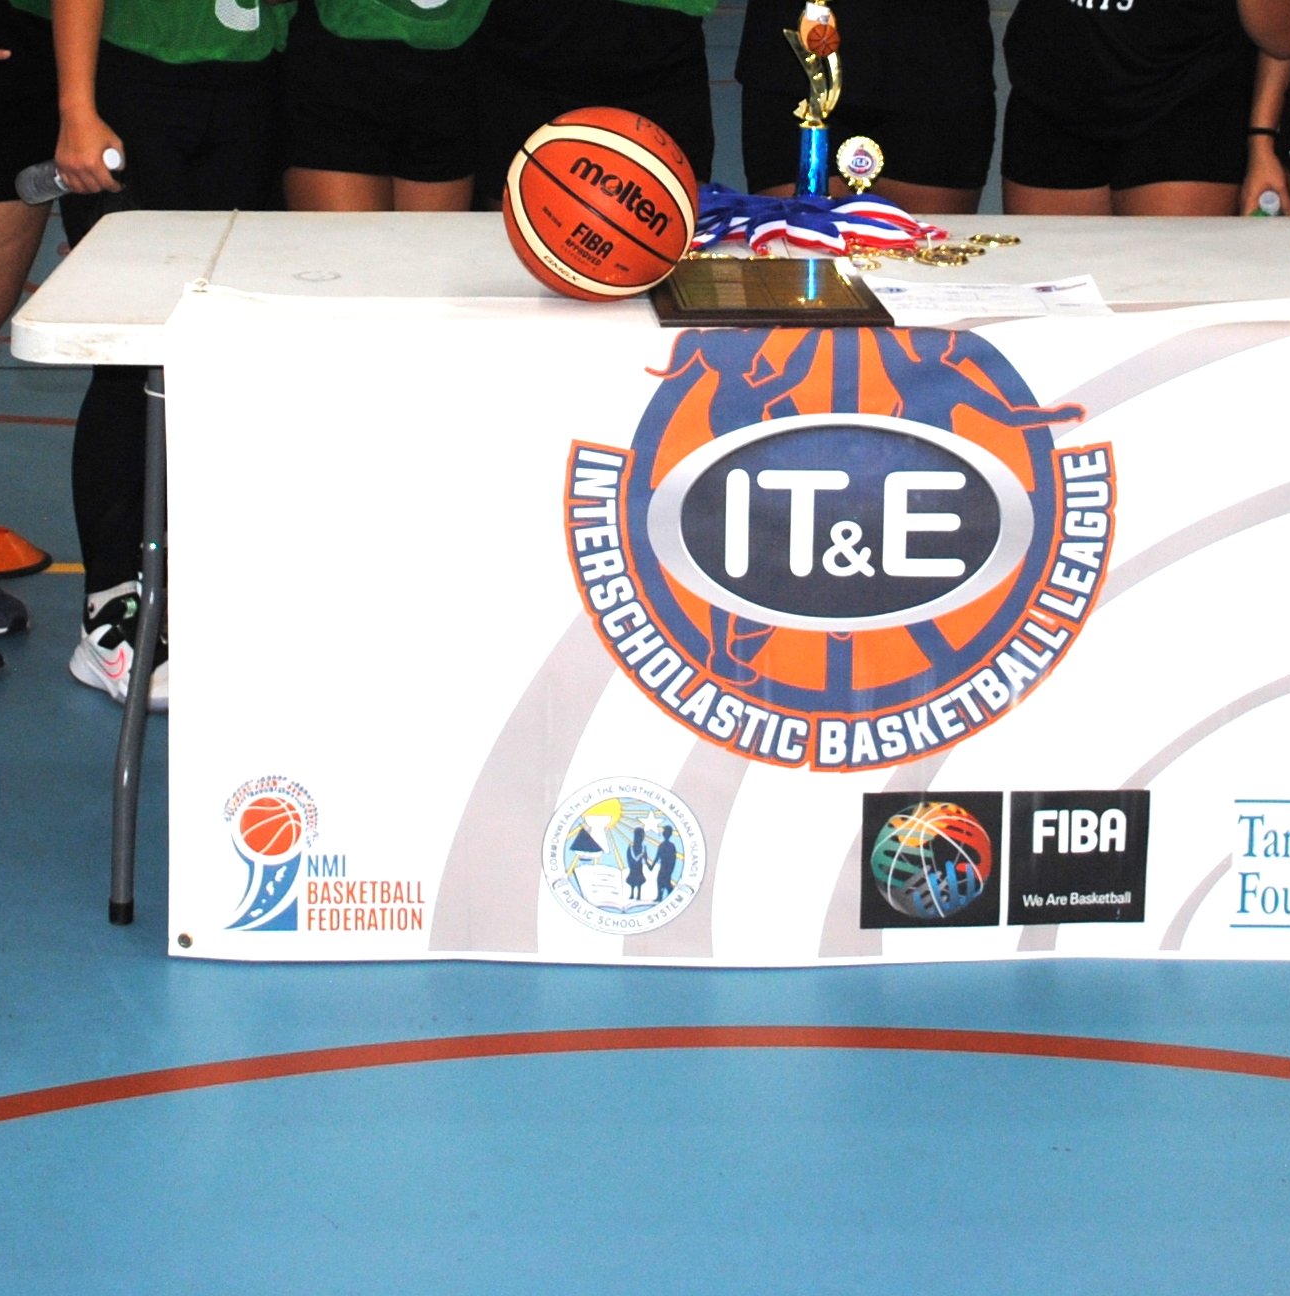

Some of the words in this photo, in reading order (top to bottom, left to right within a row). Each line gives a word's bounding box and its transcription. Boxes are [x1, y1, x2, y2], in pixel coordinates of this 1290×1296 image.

[570, 157, 669, 237] molten
[571, 222, 613, 259] FIBA
[724, 469, 967, 578] IT&E
[572, 448, 807, 761] INTERSCHOLASTIC
[819, 621, 1068, 765] BASKETBALL
[1042, 448, 1109, 619] LEAGUE
[1032, 808, 1127, 854] FIBA
[307, 854, 346, 877] NMI
[307, 880, 425, 904] BASKETBALL
[562, 890, 594, 920] PUBLIC
[597, 915, 642, 928] SCHOOL
[648, 894, 685, 924] SYSTEM
[1022, 894, 1044, 908] We
[1046, 893, 1068, 907] Are
[1070, 891, 1132, 906] Basketball
[307, 907, 423, 931] FEDERATION
